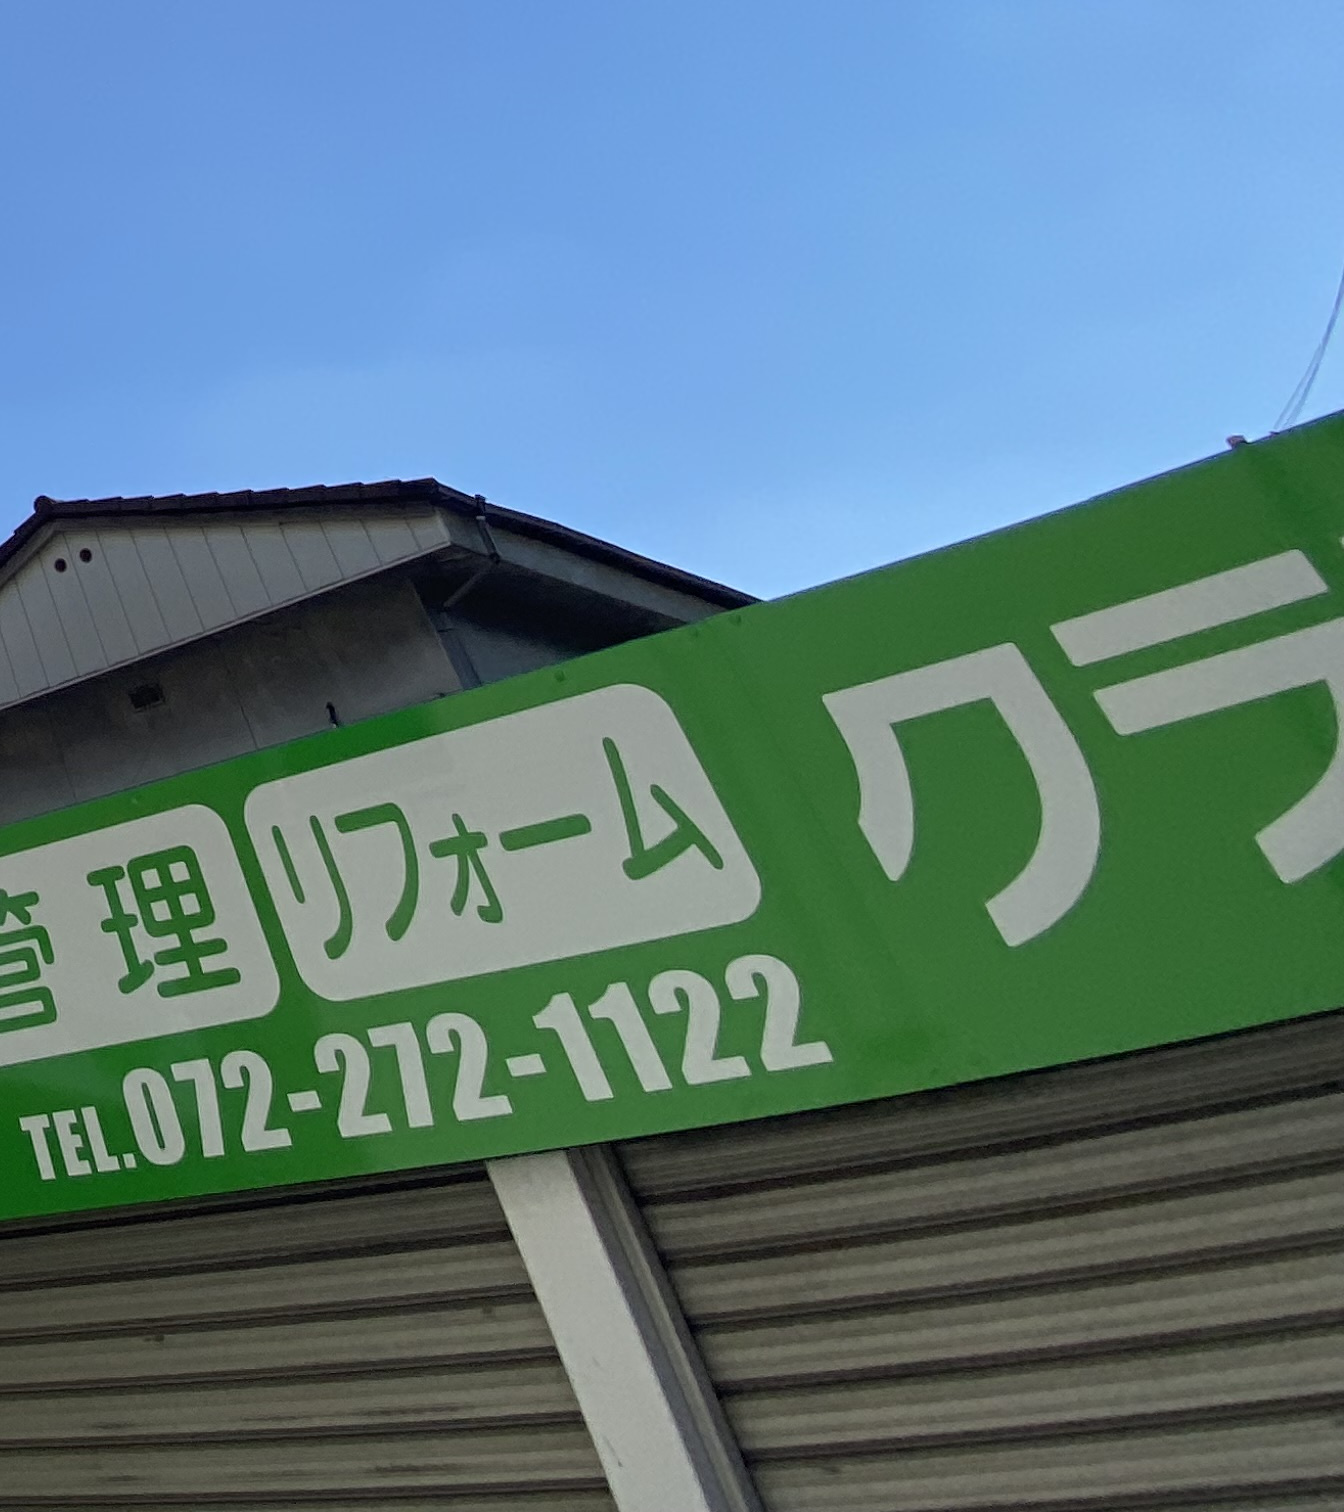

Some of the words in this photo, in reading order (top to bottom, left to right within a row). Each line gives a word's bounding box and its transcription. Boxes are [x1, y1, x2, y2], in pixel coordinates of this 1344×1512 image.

[270, 736, 725, 960] リフォーム
